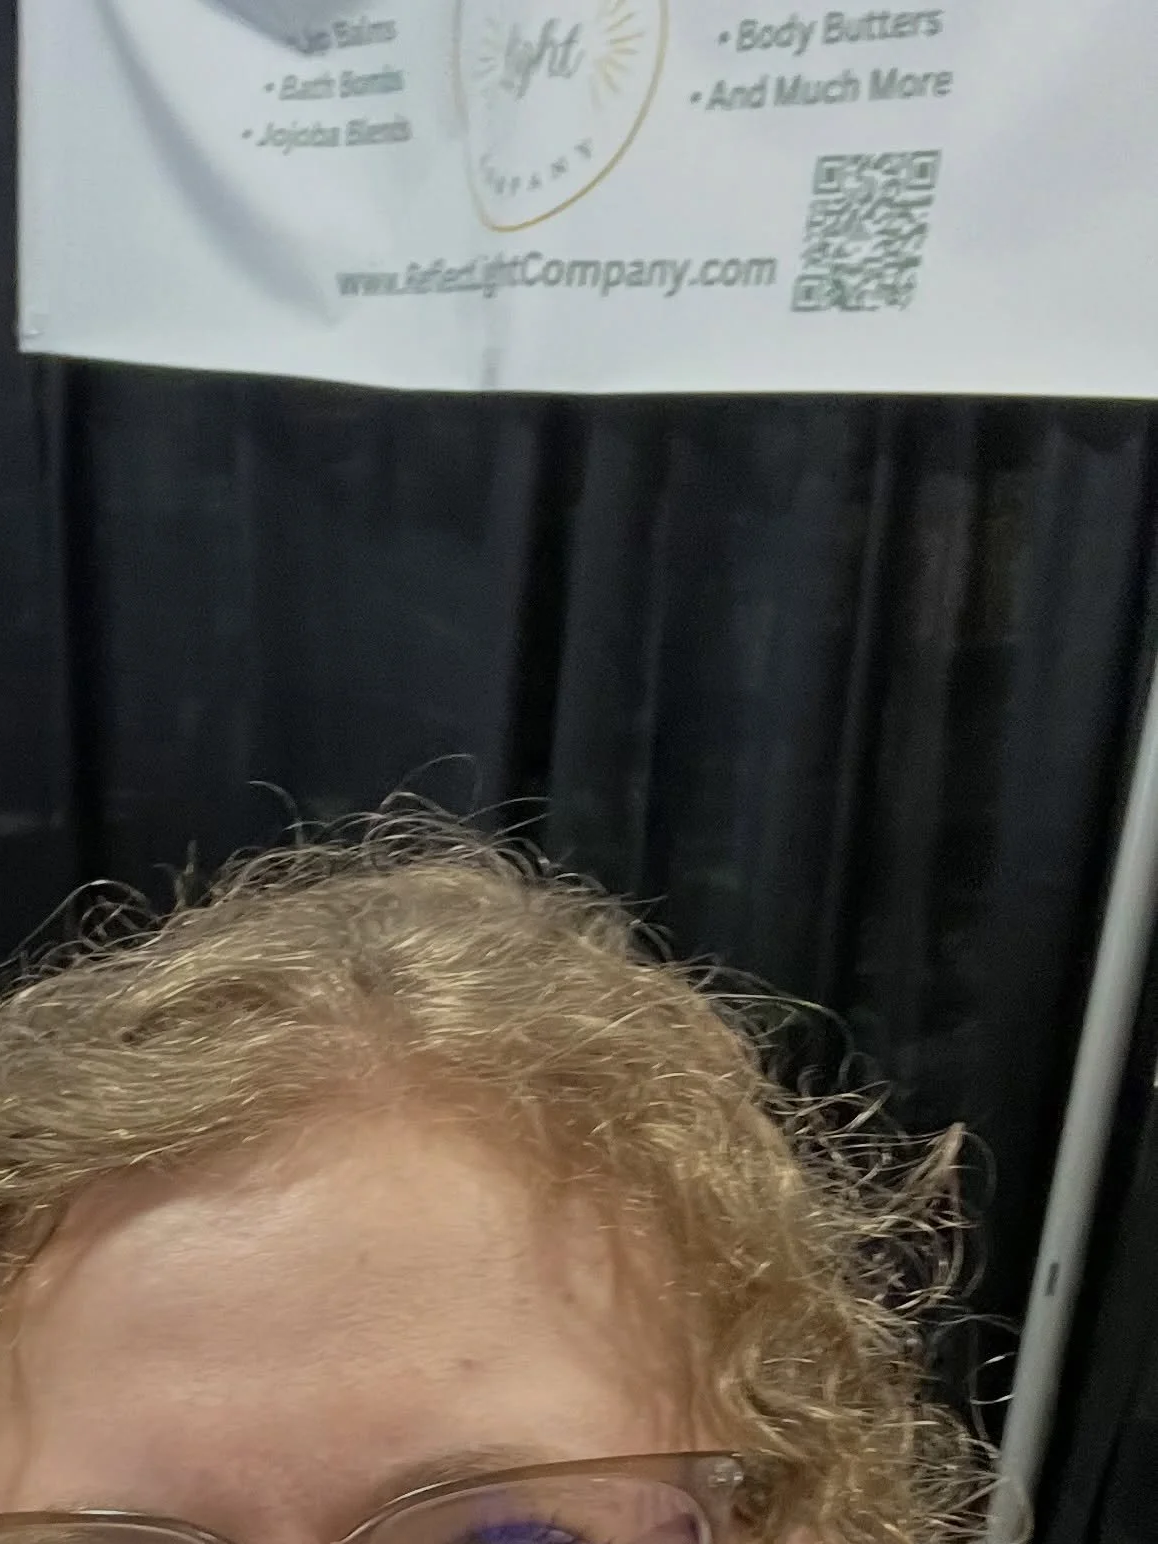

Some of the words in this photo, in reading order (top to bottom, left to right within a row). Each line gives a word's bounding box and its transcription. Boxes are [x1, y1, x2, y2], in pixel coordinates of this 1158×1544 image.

[736, 19, 818, 55] Body
[822, 9, 945, 44] Butters
[704, 75, 768, 111] And
[772, 69, 861, 106] Much
[867, 67, 952, 101] More
